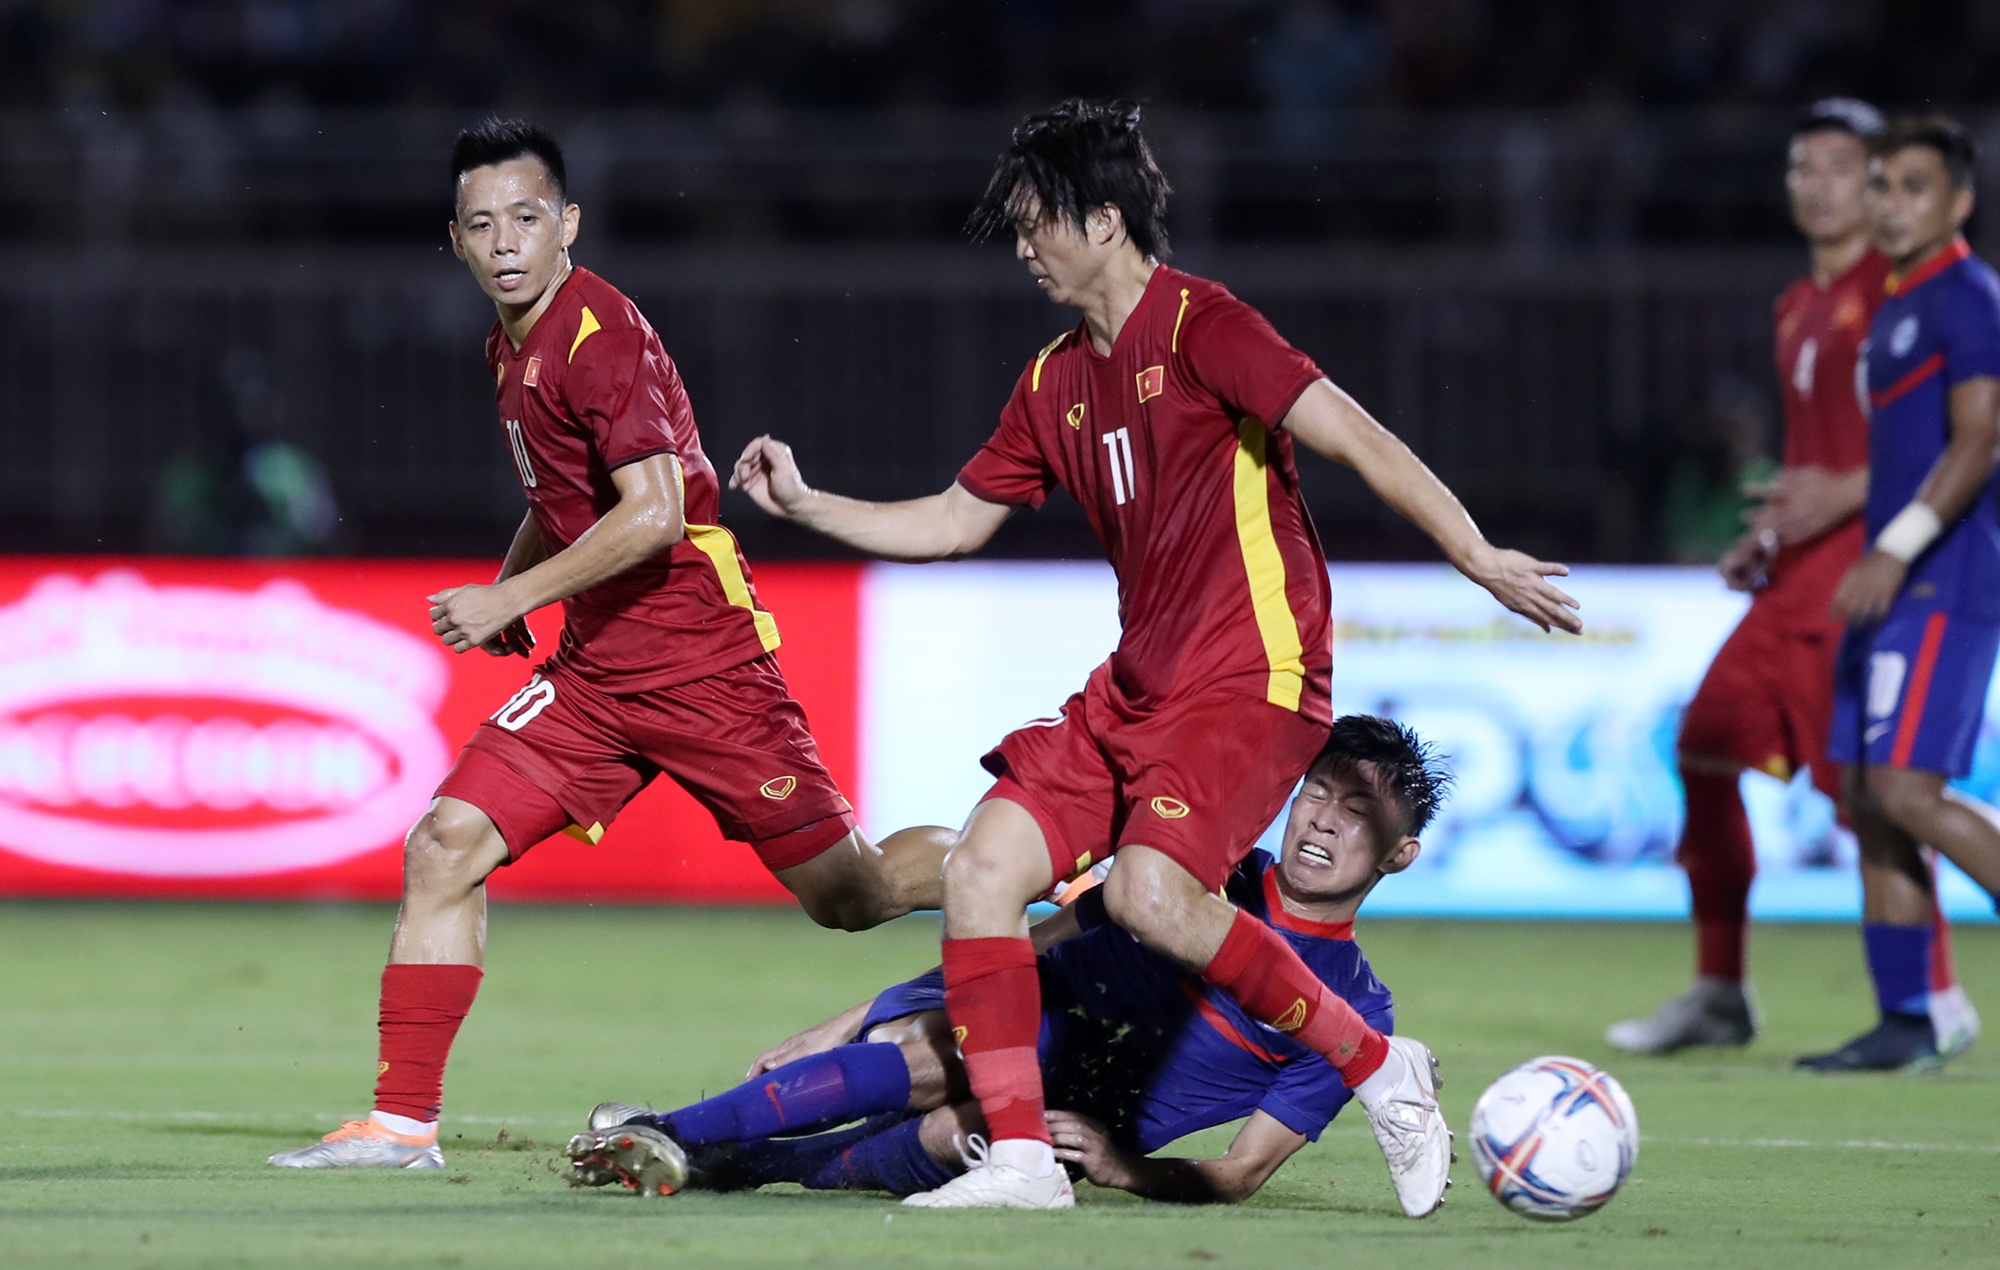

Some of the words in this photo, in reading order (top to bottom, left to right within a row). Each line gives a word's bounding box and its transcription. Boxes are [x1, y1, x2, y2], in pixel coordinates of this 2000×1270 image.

[506, 419, 537, 488] 10
[1102, 426, 1135, 505] 11
[488, 673, 556, 732] 10
